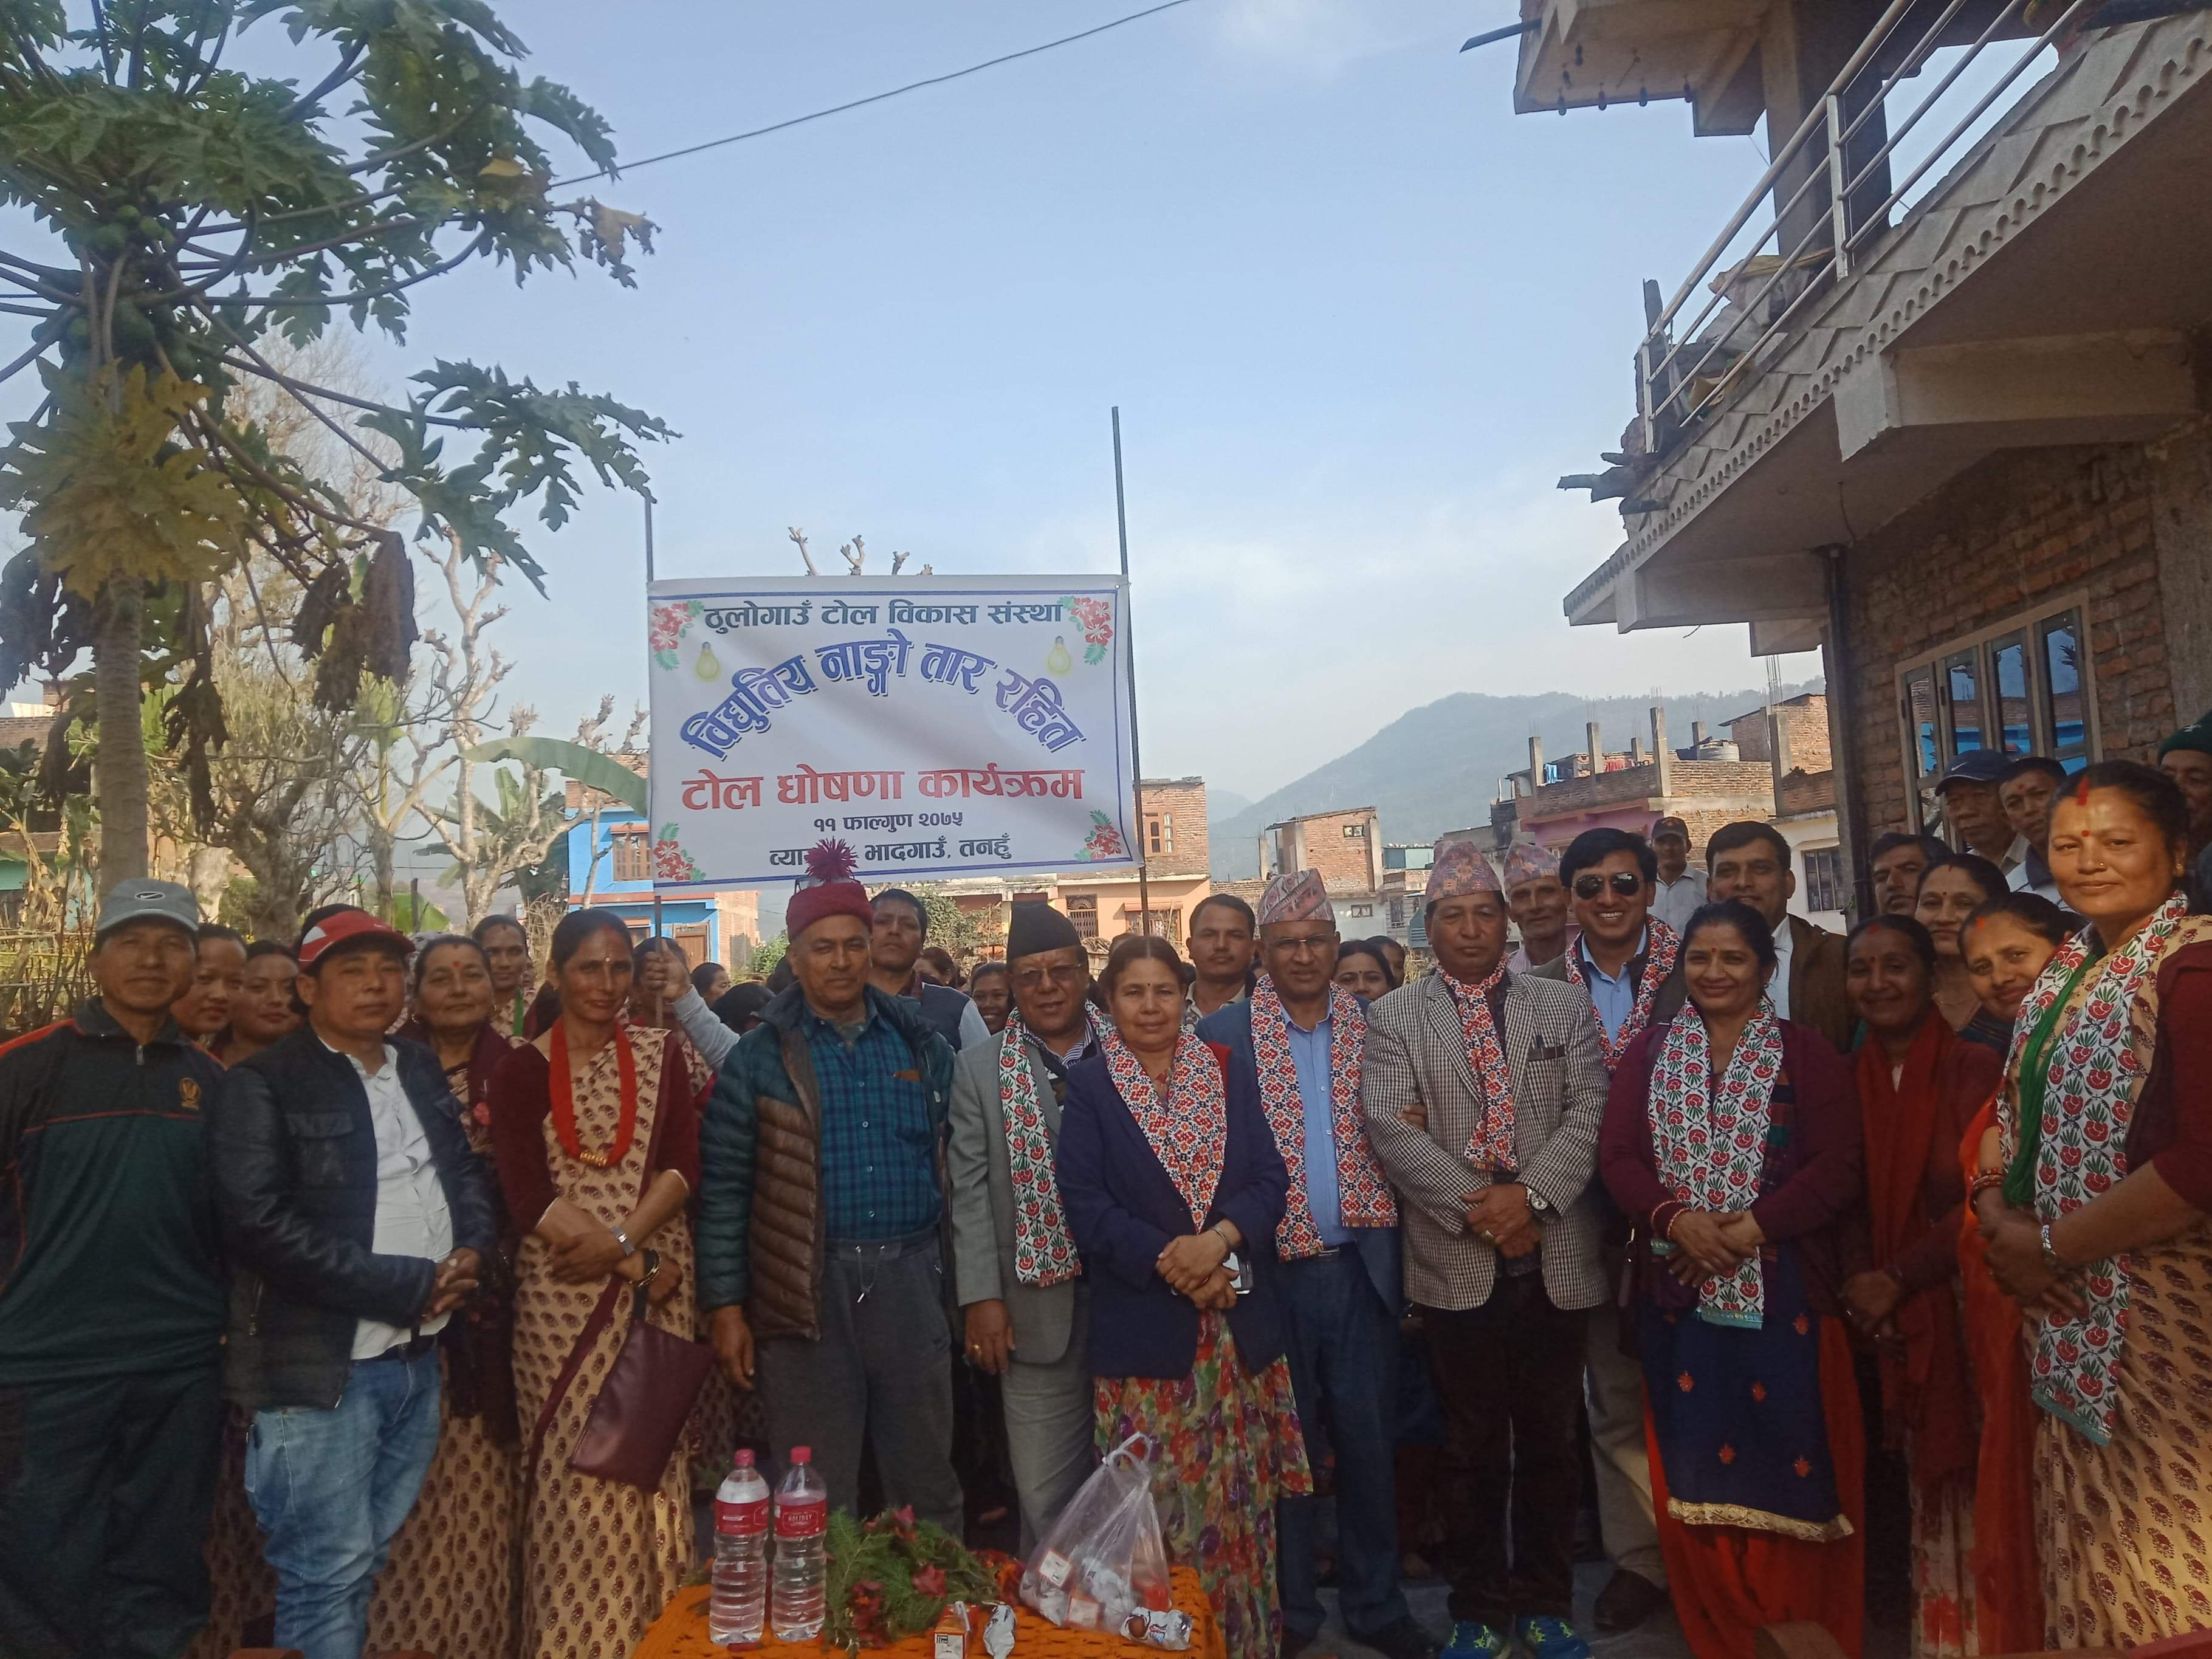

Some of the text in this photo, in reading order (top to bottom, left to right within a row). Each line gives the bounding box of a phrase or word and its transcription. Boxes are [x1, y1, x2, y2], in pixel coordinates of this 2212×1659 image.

[704, 599, 1063, 634] ठुलोगाउँ टोल विकास संस्था
[921, 643, 998, 695] तार
[995, 668, 1087, 753] रहित
[682, 769, 764, 811] टोल
[918, 763, 1085, 799] कार्यक्रम
[814, 812, 963, 833] ११ फाल्गुण २०७५
[959, 833, 1012, 860] तनहुँ
